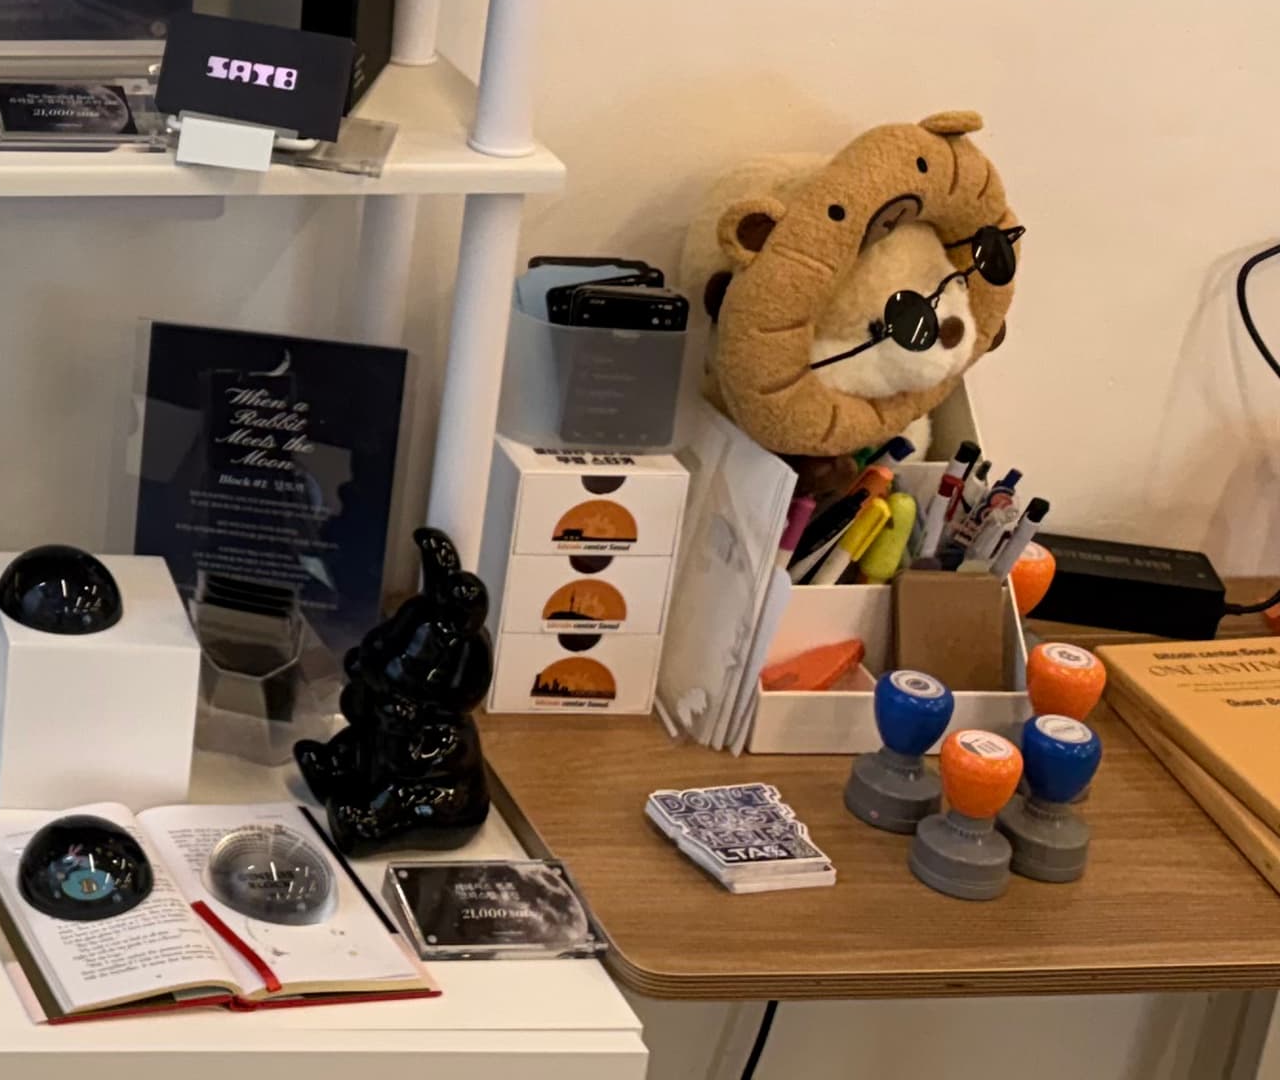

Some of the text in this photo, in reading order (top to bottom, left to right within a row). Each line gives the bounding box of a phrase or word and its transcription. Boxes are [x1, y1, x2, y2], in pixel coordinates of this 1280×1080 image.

[32, 108, 75, 117] 21,000
[224, 386, 310, 412] When a
[229, 409, 308, 432] Rabbit
[215, 429, 315, 454] Meets the
[230, 449, 294, 470] Moon
[608, 543, 630, 551] Seoul
[1148, 664, 1195, 677] ONE
[673, 806, 781, 828] TRUST
[689, 823, 799, 845] VERIFY
[462, 908, 507, 919] 21,000
